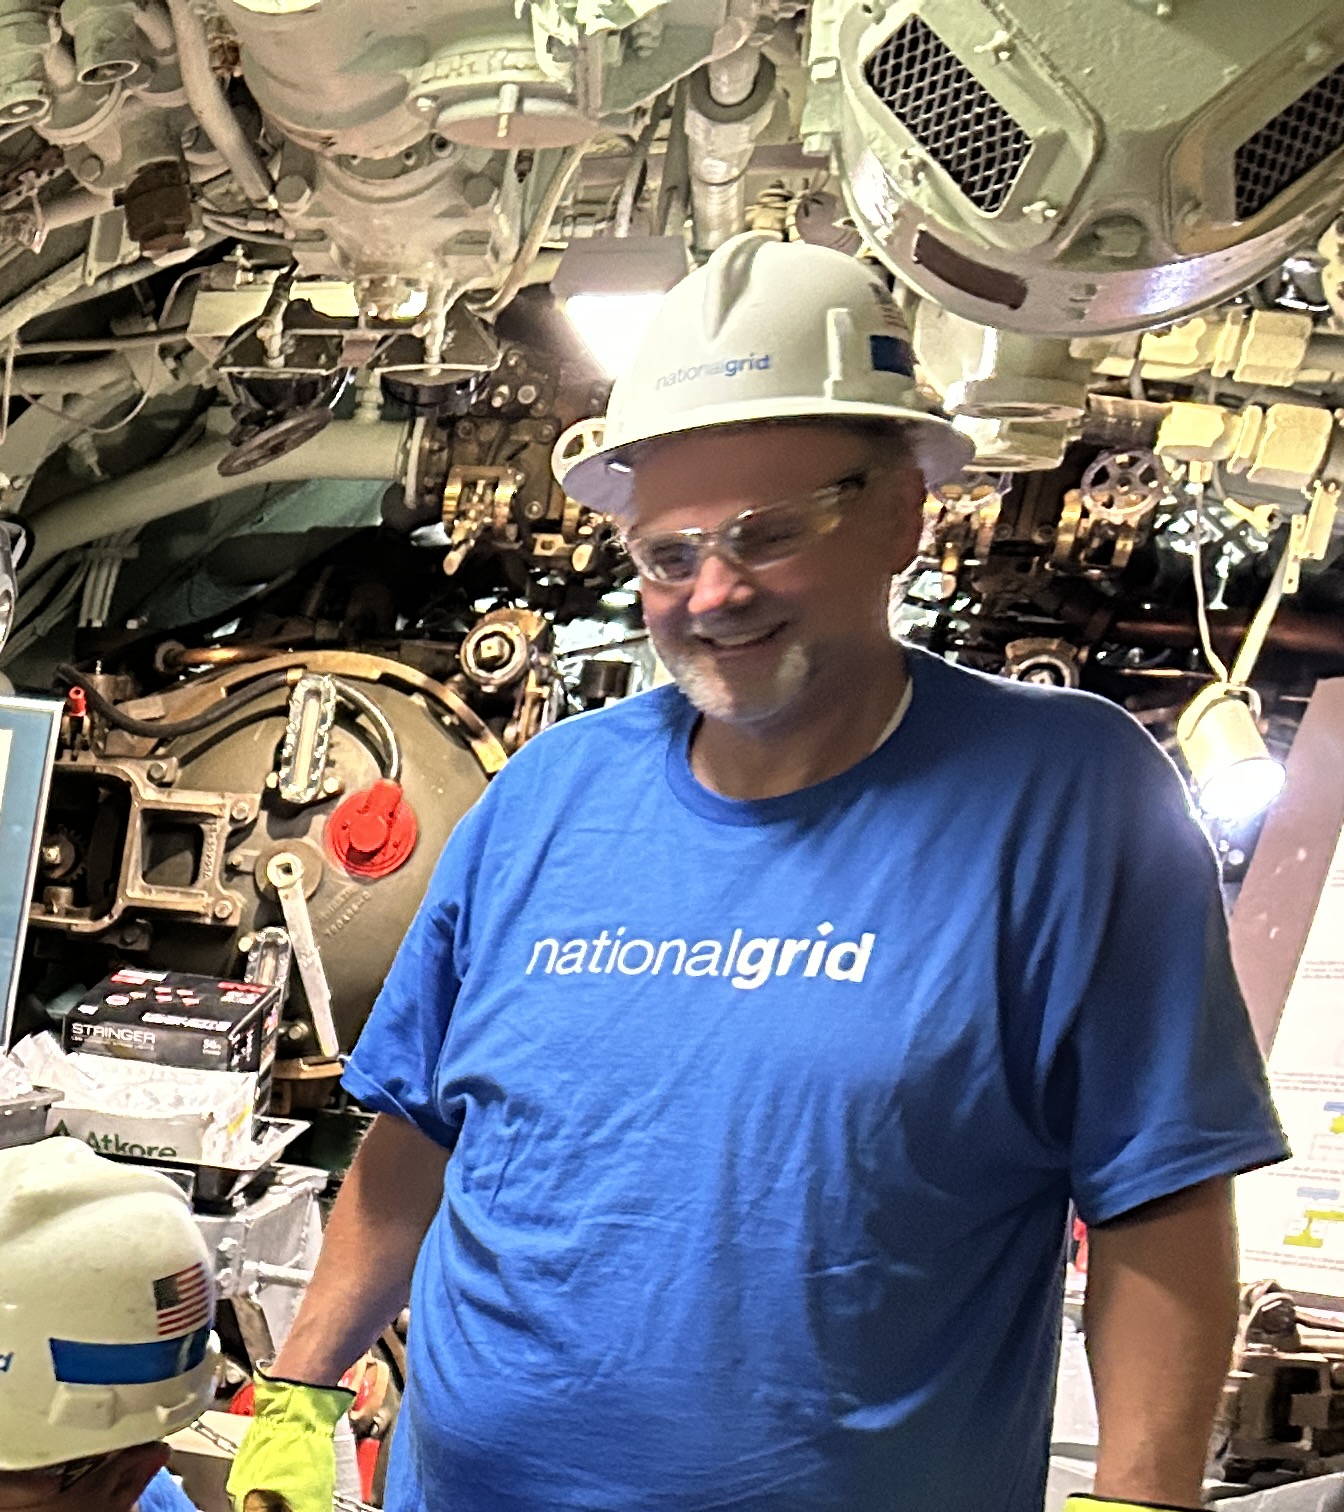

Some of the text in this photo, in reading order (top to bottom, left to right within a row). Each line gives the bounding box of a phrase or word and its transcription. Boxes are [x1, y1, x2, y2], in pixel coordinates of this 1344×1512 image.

[655, 352, 771, 391] nationalgrid
[525, 921, 876, 990] nationalgrid
[71, 1023, 156, 1045] STRINGER
[86, 1130, 178, 1158] Atkore
